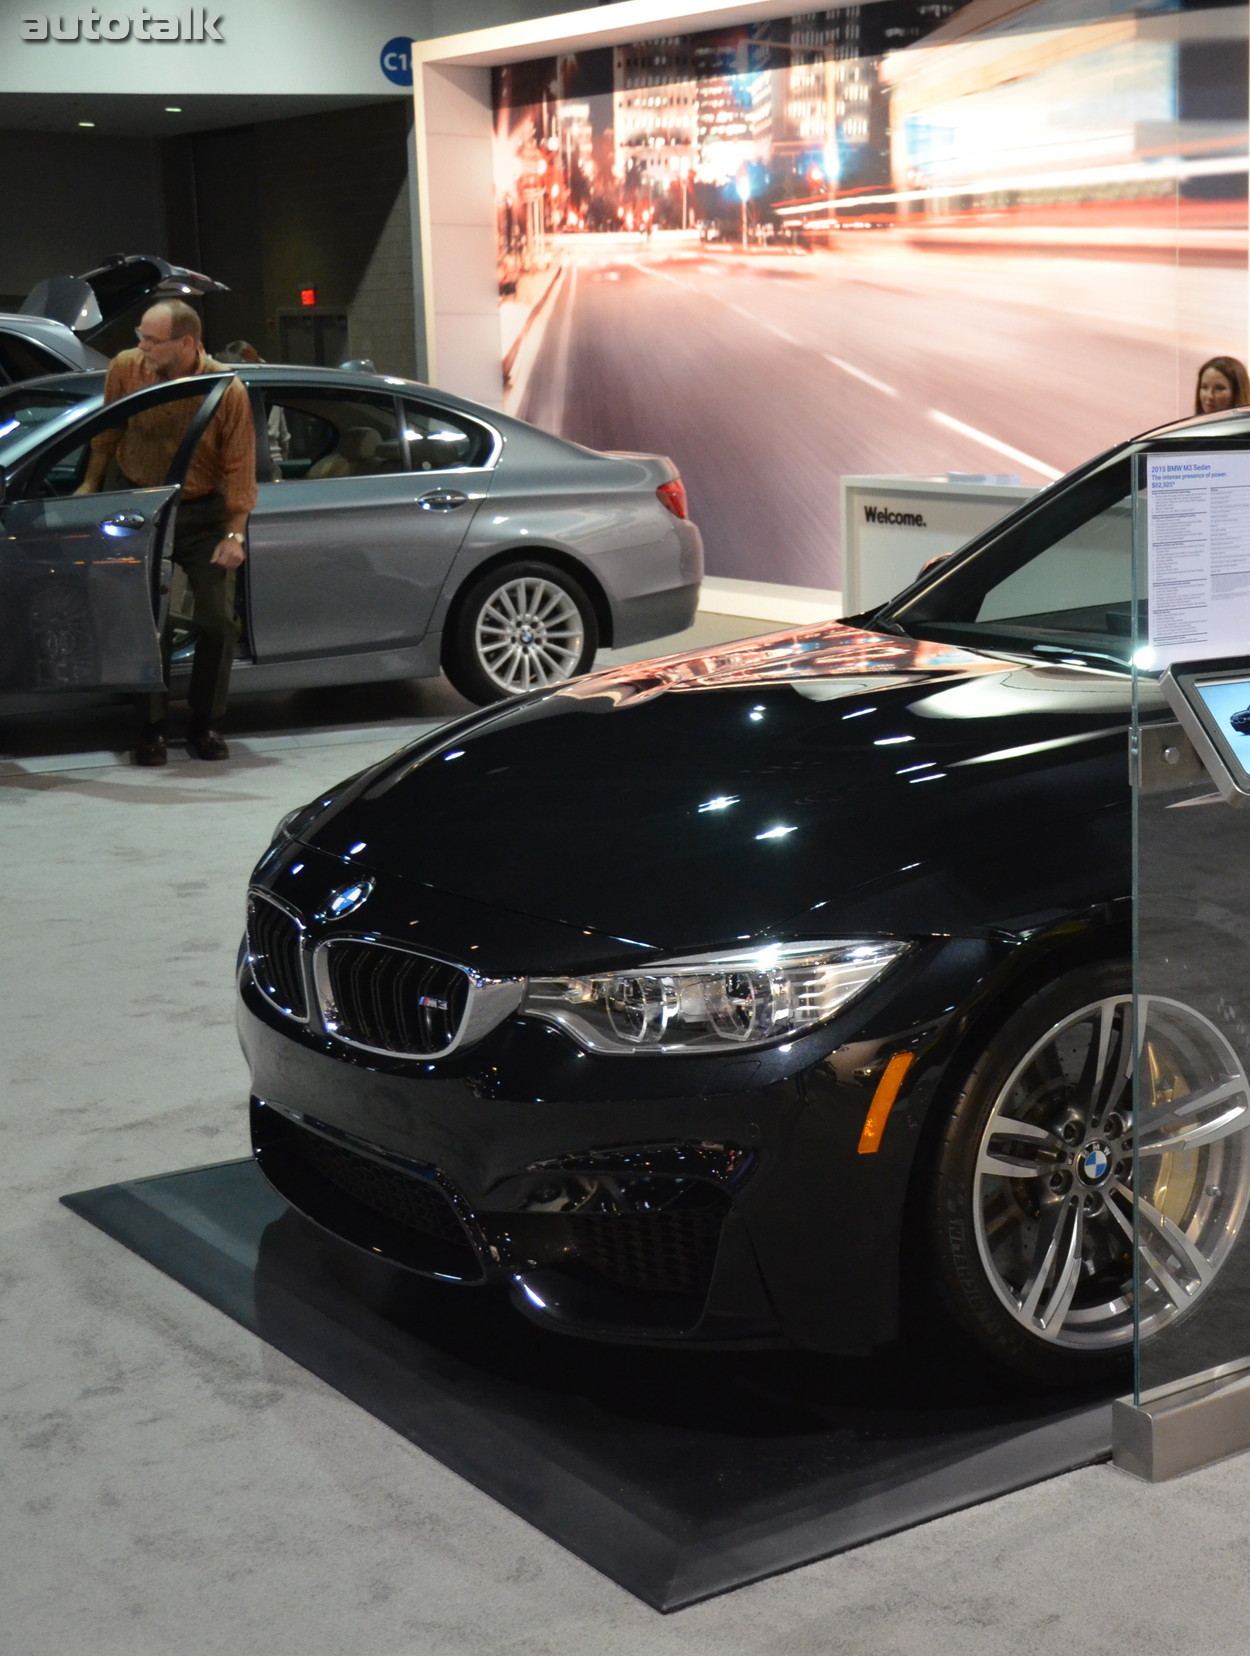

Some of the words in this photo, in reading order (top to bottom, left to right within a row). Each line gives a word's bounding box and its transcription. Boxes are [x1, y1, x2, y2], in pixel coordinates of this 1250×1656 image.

[384, 52, 412, 71] C1
[1151, 465, 1166, 473] 2015
[864, 505, 927, 527] Welcome.
